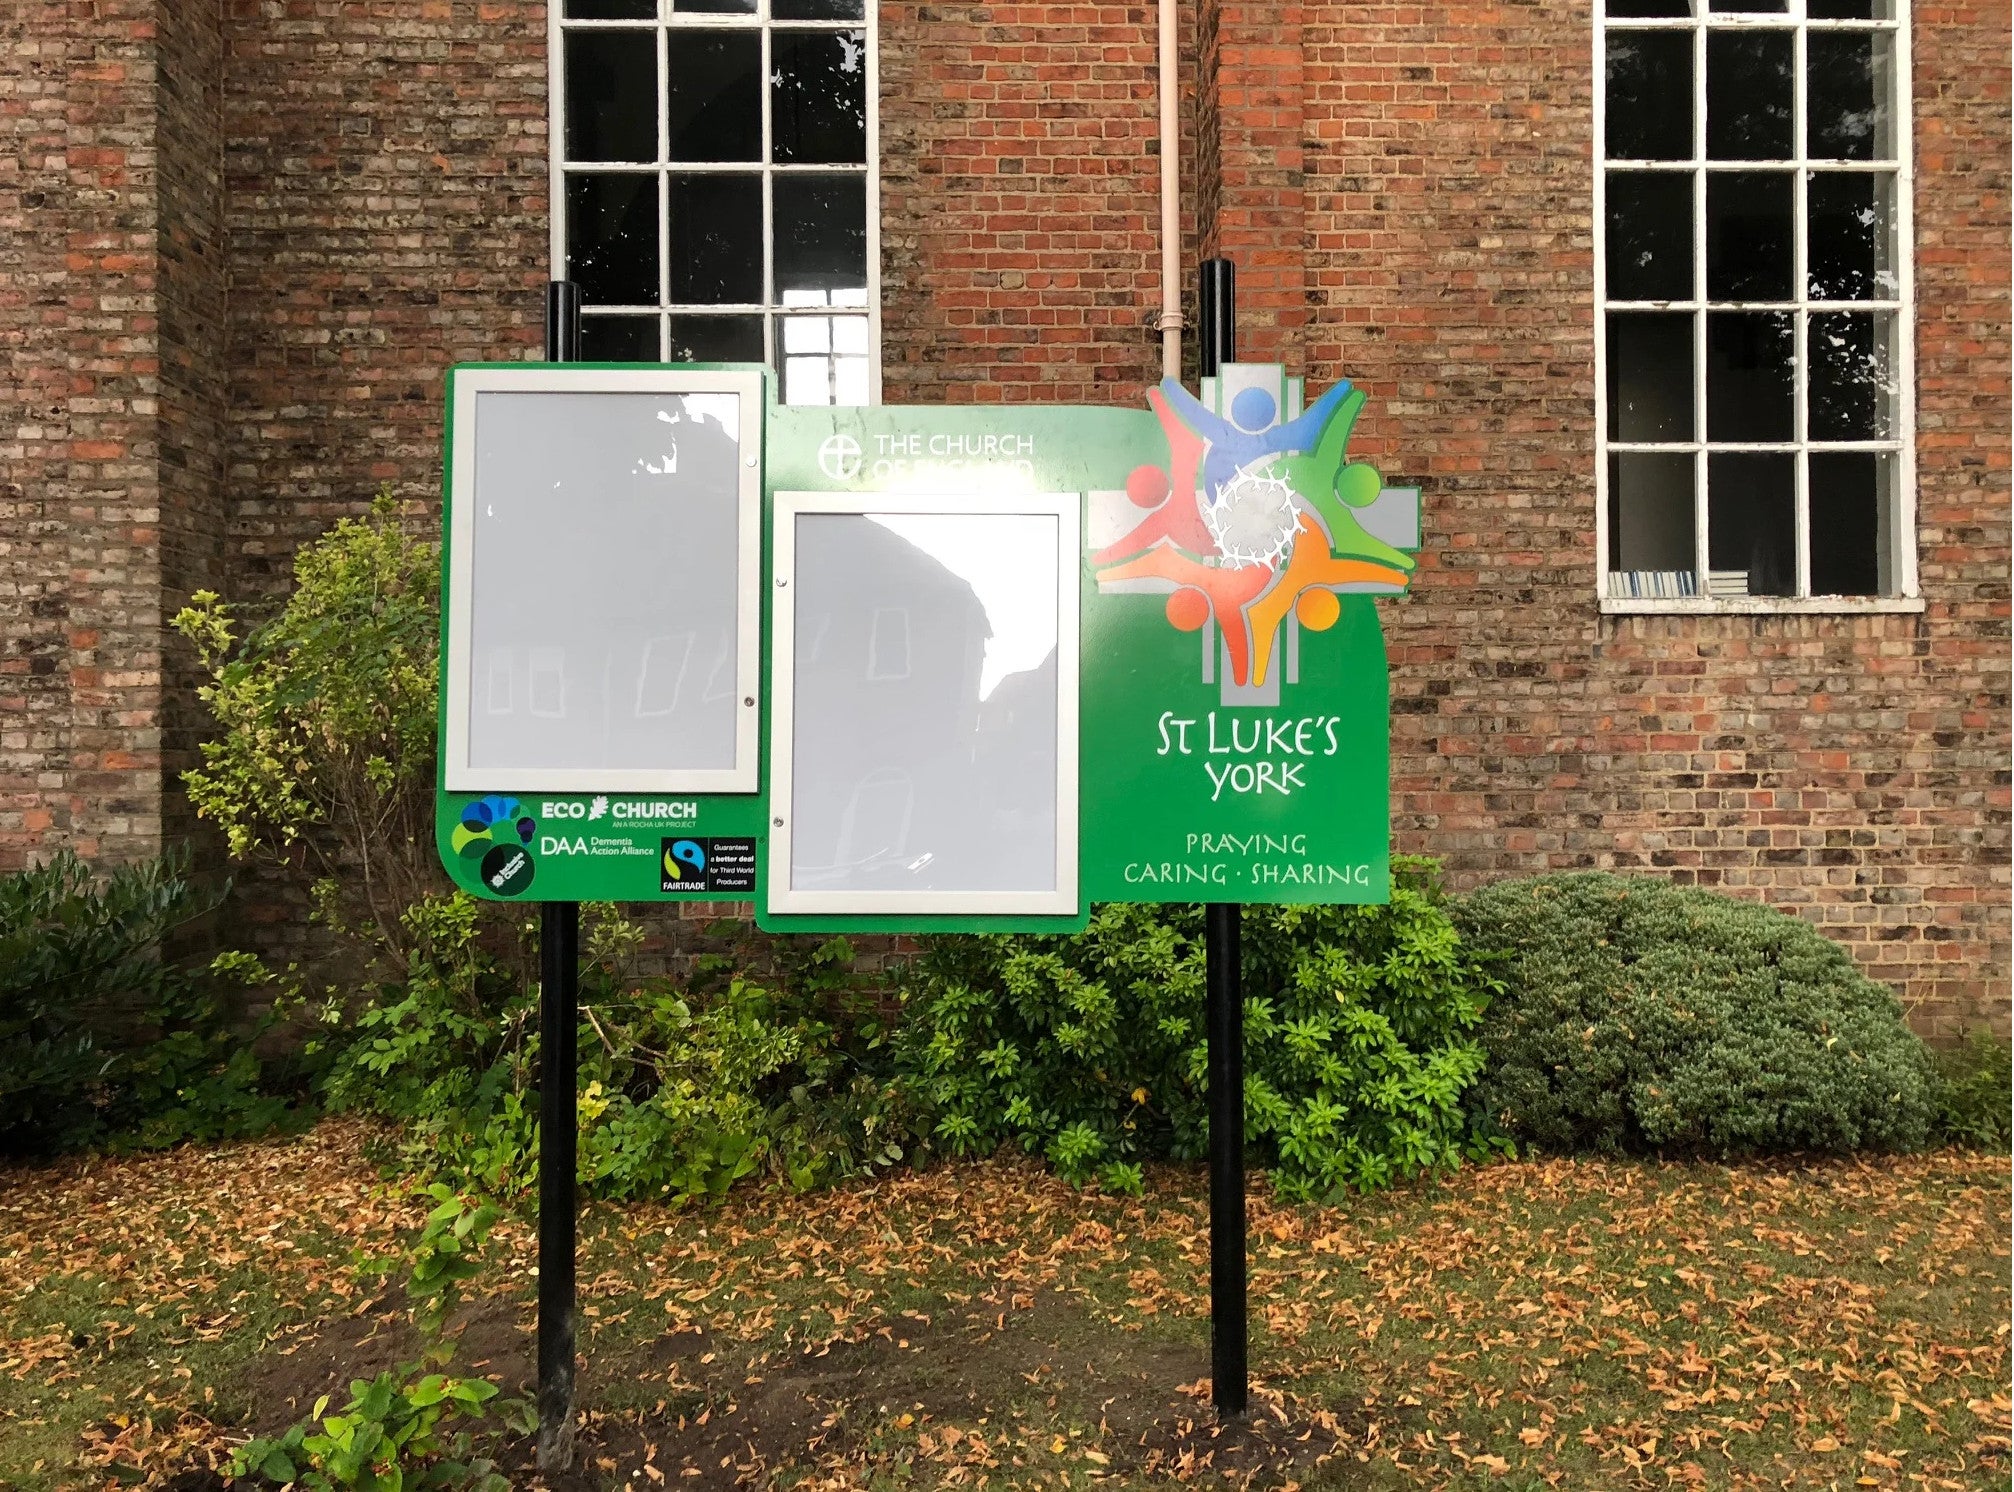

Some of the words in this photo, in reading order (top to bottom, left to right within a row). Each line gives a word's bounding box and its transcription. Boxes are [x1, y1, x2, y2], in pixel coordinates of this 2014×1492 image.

[874, 434, 920, 456] THE
[929, 434, 1033, 456] CHURCH
[1156, 711, 1196, 755] ST
[1207, 711, 1341, 755] LUKE'S
[1203, 761, 1306, 801] YORK
[541, 801, 585, 819] ECO
[611, 801, 697, 819] CHURCH
[540, 836, 588, 856] DAA
[591, 837, 632, 846] Dementia
[590, 847, 618, 856] Action
[620, 847, 655, 856] Alliance
[1186, 833, 1306, 856] PRAYING
[1124, 862, 1227, 886] CARING
[1251, 863, 1369, 886] SHARING
[663, 881, 706, 890] FAIRTRADE
